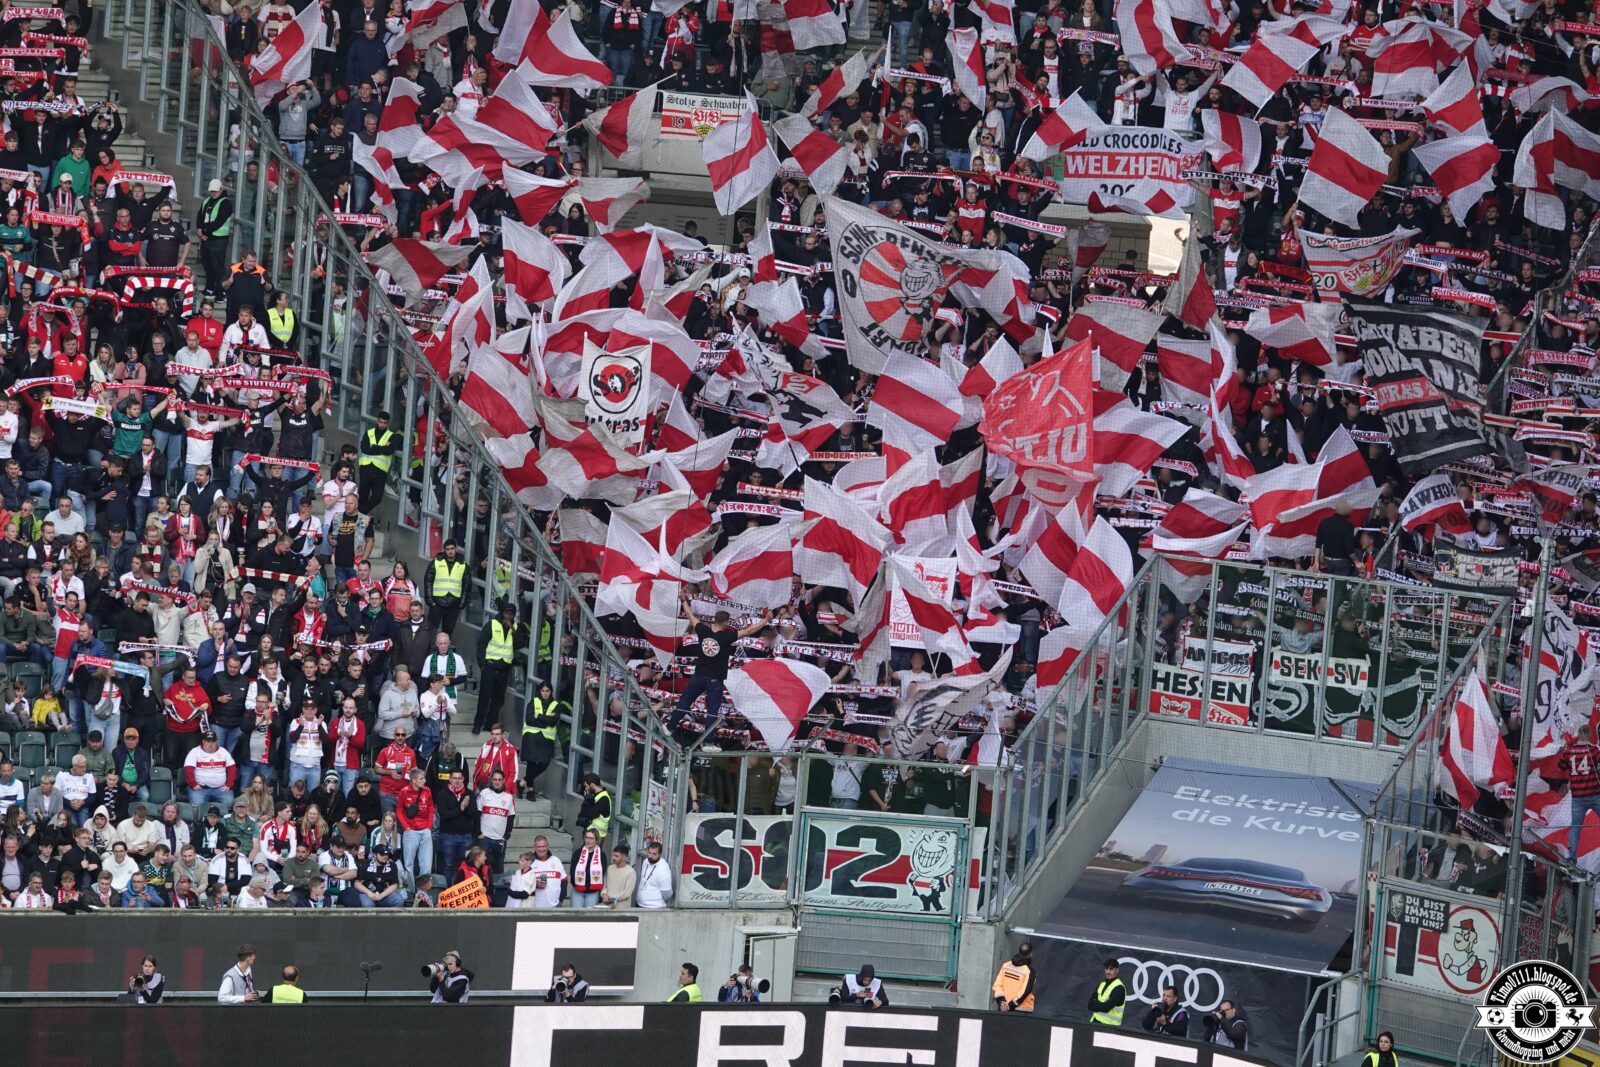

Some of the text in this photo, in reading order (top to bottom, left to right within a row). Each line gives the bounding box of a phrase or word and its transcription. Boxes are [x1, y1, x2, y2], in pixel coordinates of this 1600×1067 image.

[1291, 75, 1348, 86] STUTTGART
[666, 94, 748, 110] Stolze Schwaben
[247, 380, 292, 390] STUTTGART
[719, 502, 771, 514] NECKAR
[1219, 663, 1250, 675] 2010
[1280, 655, 1361, 686] SEK SV
[1151, 669, 1247, 704] HESEN
[1568, 755, 1591, 777] 14
[1171, 808, 1232, 826] die
[1405, 894, 1446, 912] DU BIST
[1404, 905, 1445, 922] IMMER
[1404, 914, 1445, 931] BEI UNS!
